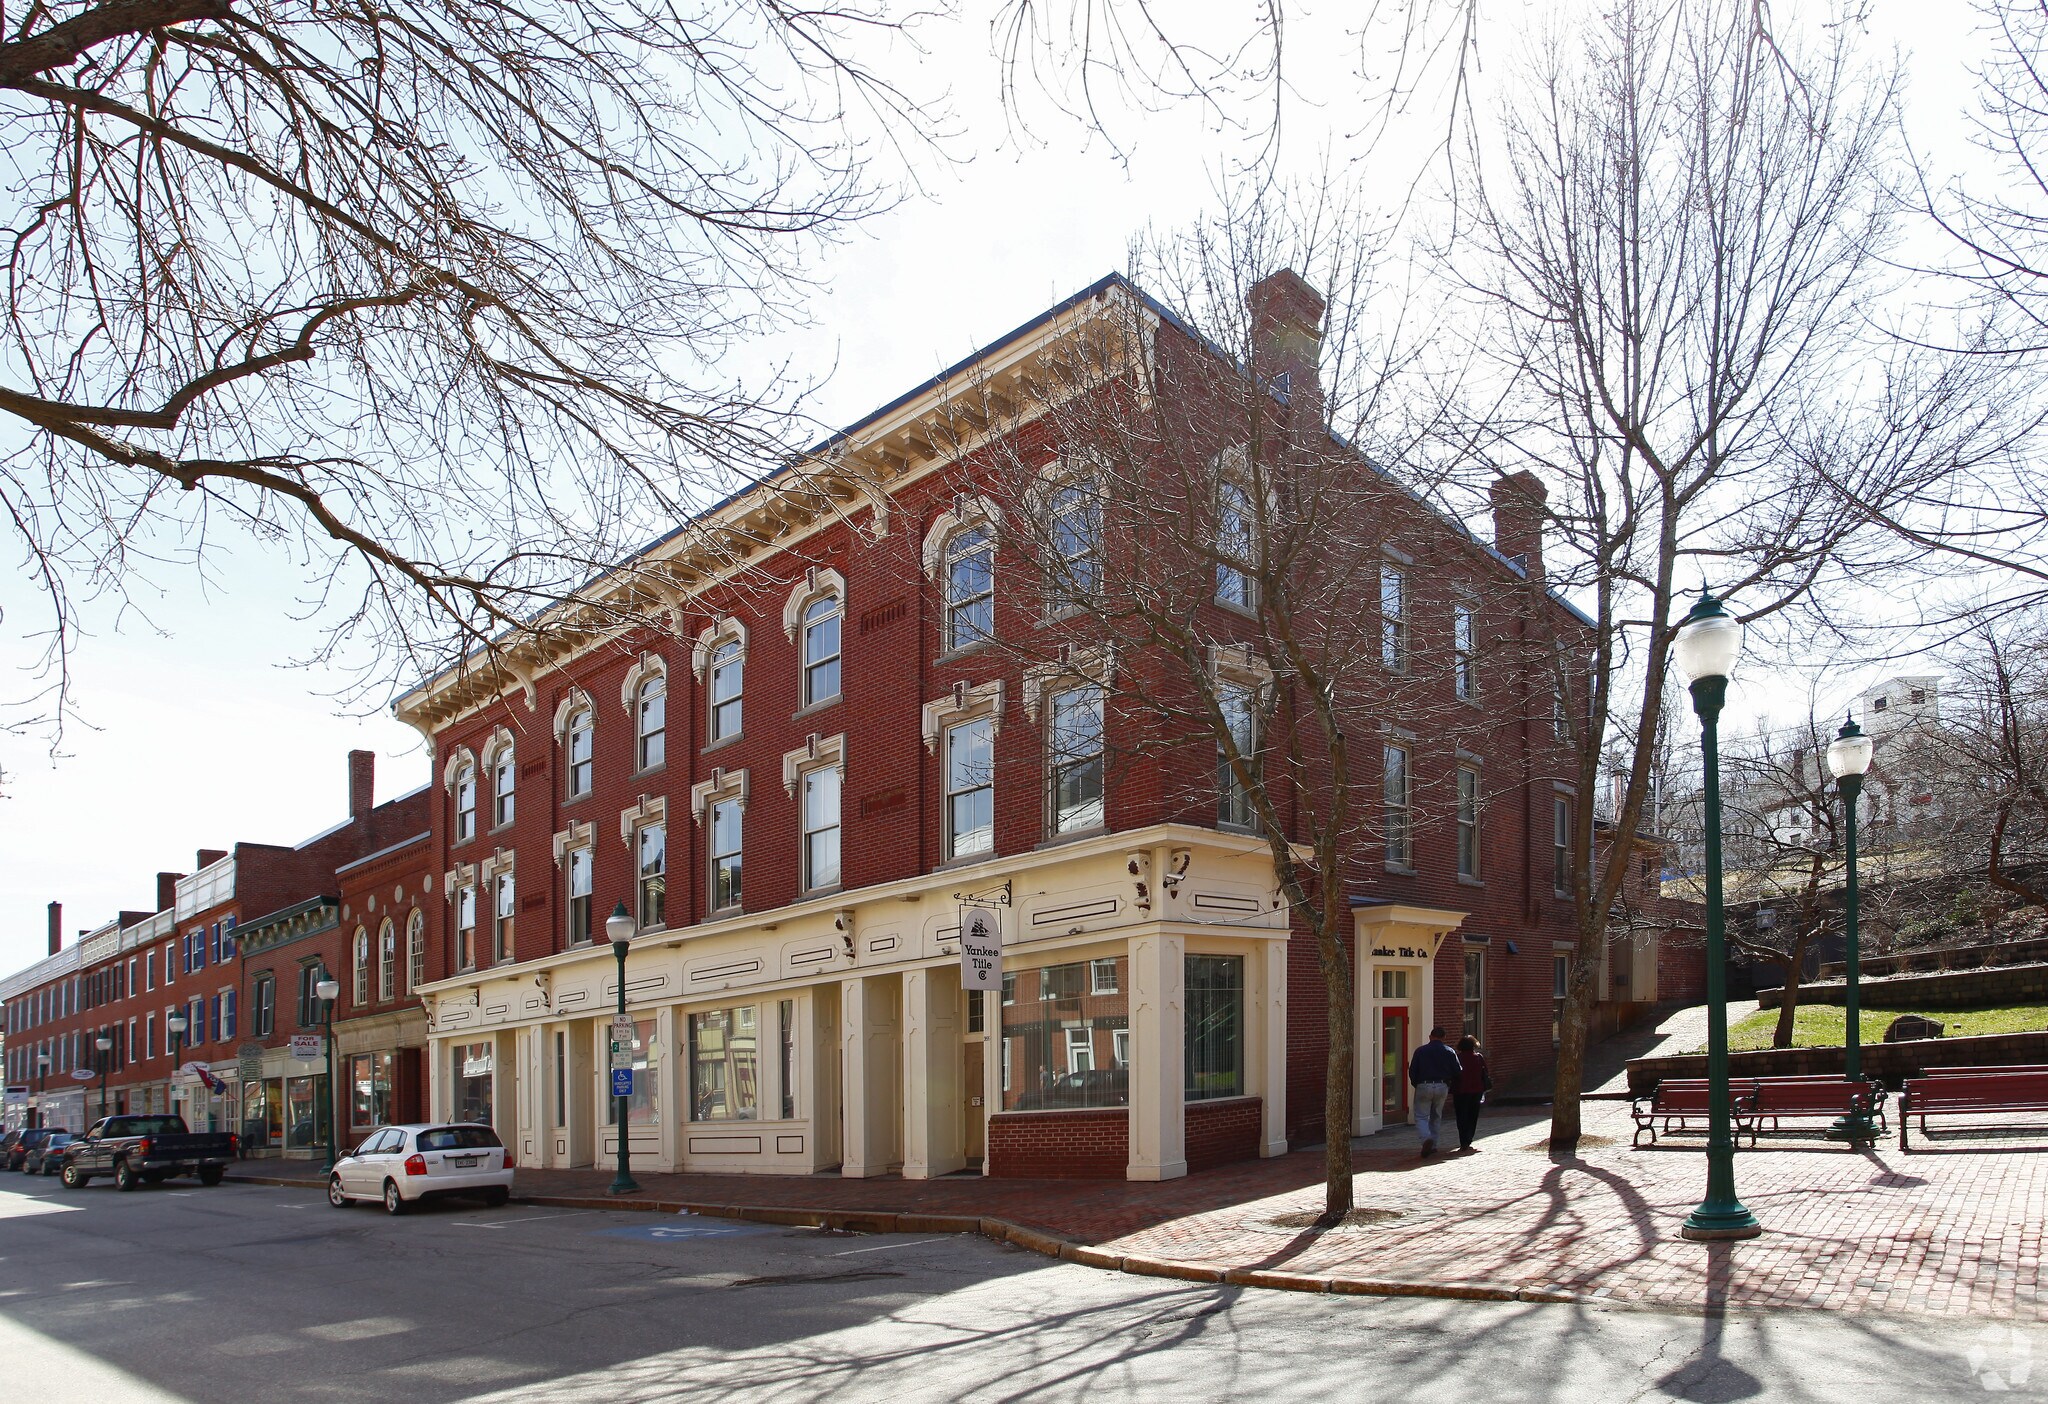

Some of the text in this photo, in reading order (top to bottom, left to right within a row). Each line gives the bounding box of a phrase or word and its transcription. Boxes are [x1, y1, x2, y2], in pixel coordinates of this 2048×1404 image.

[964, 944, 998, 956] Yankee
[1372, 946, 1395, 956] ankee
[1399, 947, 1414, 957] Title
[972, 958, 992, 969] Title
